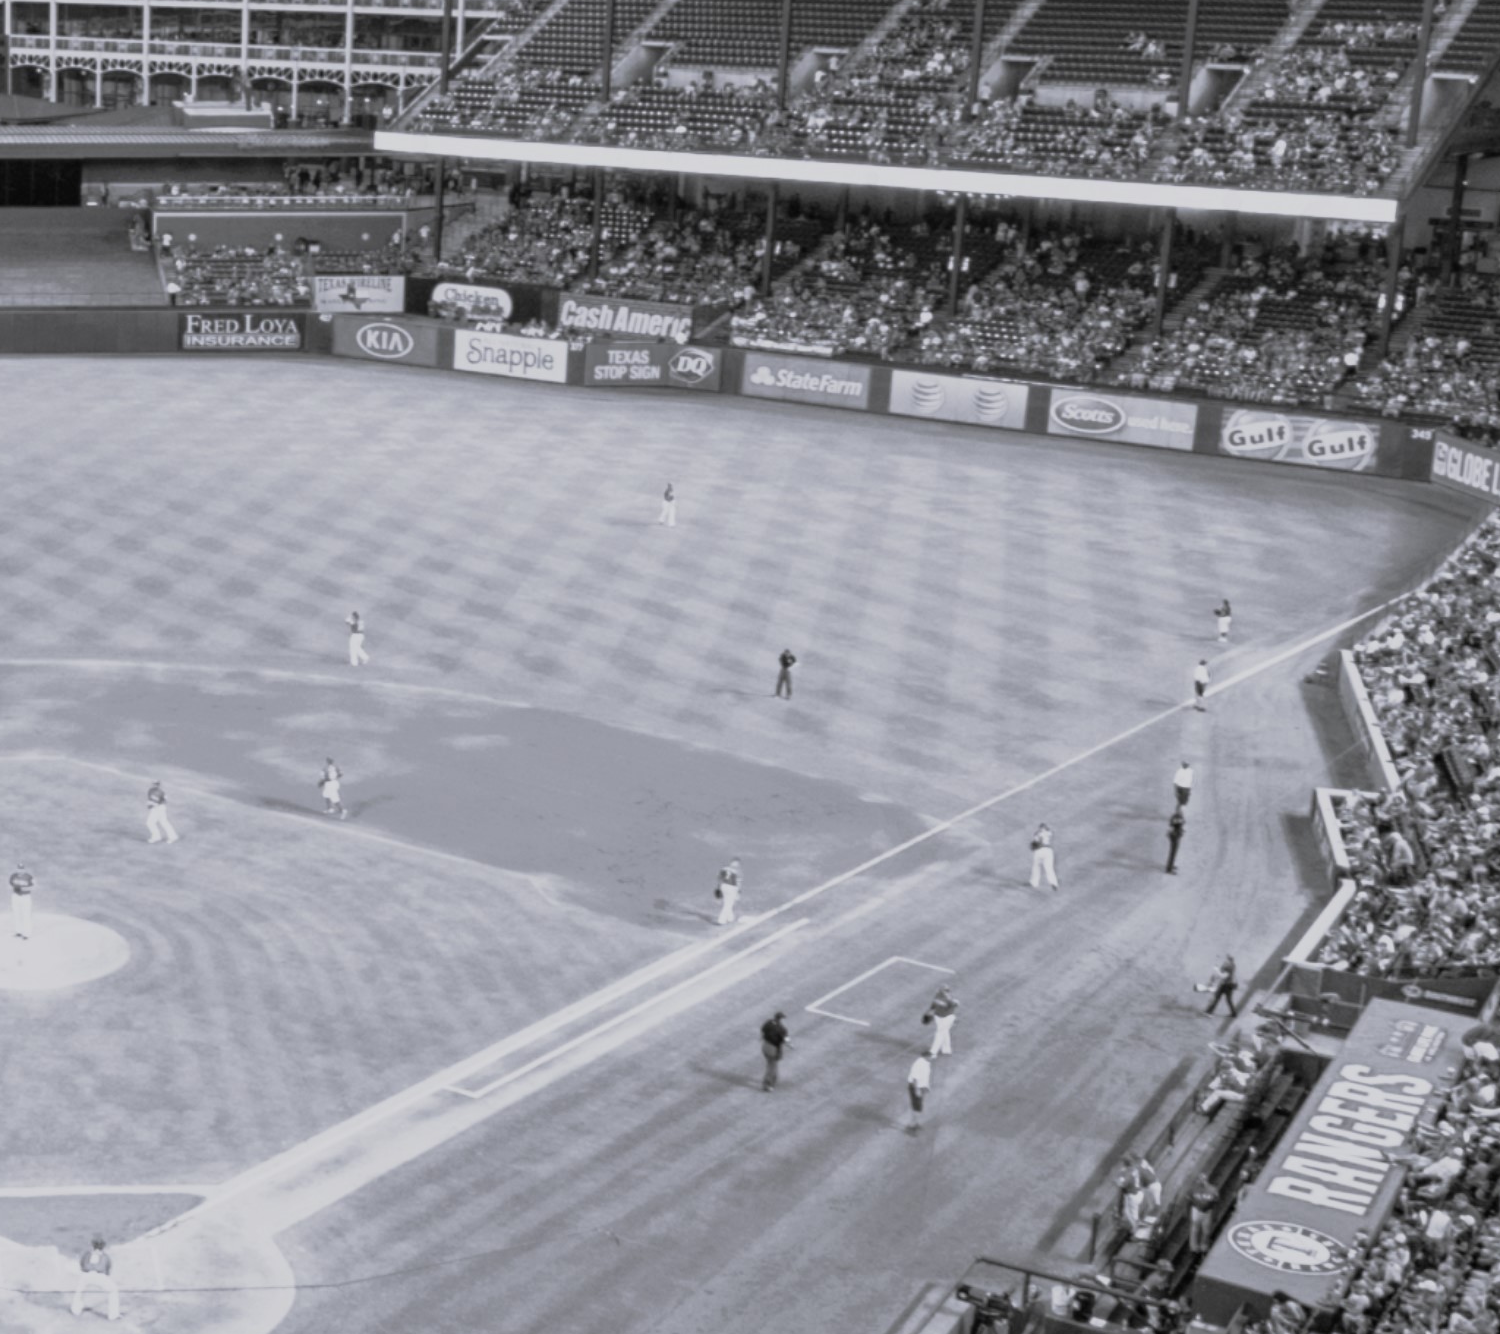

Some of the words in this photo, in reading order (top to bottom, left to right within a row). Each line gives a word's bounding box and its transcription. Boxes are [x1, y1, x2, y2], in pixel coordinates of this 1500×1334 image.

[444, 288, 499, 308] Chicken
[186, 315, 243, 335] FRED
[245, 315, 299, 335] LOYA
[187, 335, 298, 347] INSURANCE
[365, 329, 404, 352] KIA
[466, 338, 554, 374] Snapple
[608, 349, 651, 365] TEXAS
[676, 355, 707, 376] DQ
[593, 364, 628, 380] STOP
[629, 364, 661, 380] SIGN
[1060, 405, 1114, 425] Scotts
[1228, 425, 1287, 448] Gulf
[1308, 436, 1369, 459] Gulf
[1446, 447, 1492, 493] GLOBE
[1266, 1063, 1433, 1217] RANGERS
